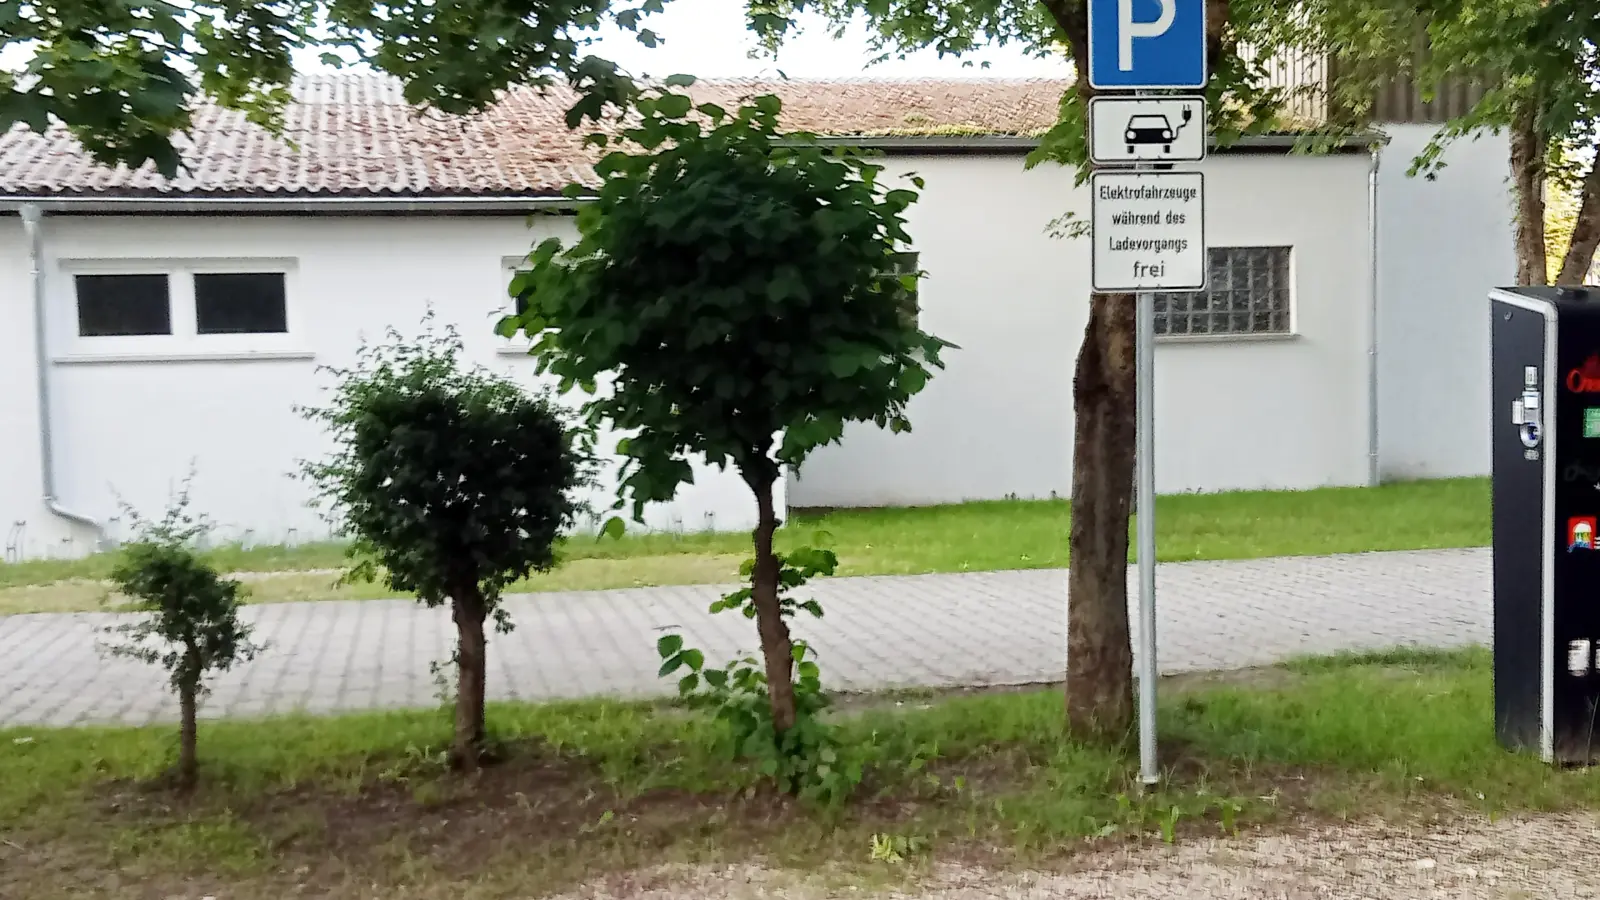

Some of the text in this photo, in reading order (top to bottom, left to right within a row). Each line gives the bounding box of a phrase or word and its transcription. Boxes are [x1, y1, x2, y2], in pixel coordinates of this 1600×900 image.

[1118, 0, 1176, 71] P
[1099, 184, 1197, 203] Elektrofahrzeuge
[1111, 210, 1186, 225] während des
[1109, 236, 1188, 254] Ladevorgangs
[1133, 260, 1165, 278] frei
